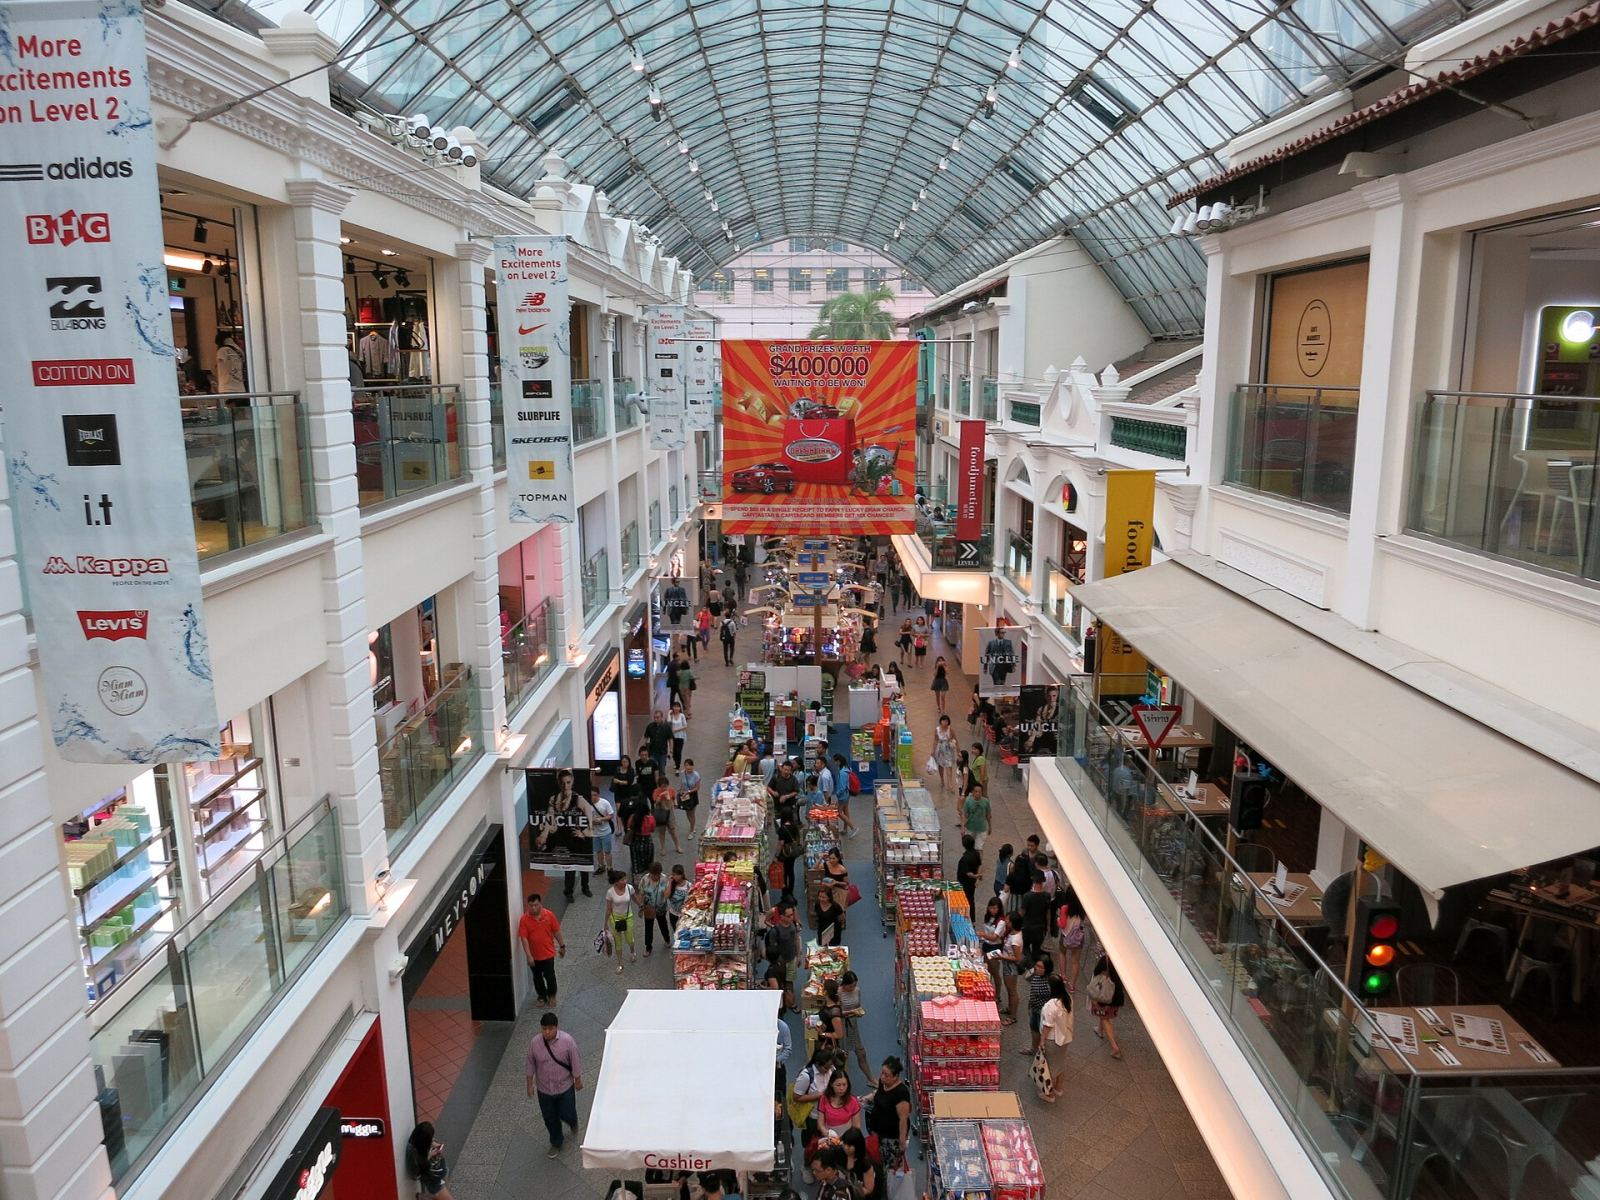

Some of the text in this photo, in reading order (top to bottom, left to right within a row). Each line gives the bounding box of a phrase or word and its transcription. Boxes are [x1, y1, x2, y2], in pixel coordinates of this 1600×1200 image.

[18, 35, 82, 58] More
[0, 66, 132, 91] xcitements
[30, 98, 98, 122] Level
[105, 97, 120, 119] 2
[47, 157, 133, 180] adidas
[28, 212, 110, 243] BHG
[518, 248, 543, 256] More
[502, 260, 561, 269] Excitements
[522, 271, 548, 280] Level
[551, 271, 556, 279] 2
[769, 344, 872, 353] GRAND PRIZES WORTH
[38, 364, 130, 381] COTTON ON
[517, 411, 560, 422] SLURPLIFE
[511, 436, 569, 445] SKECHERS
[967, 446, 981, 519] foodjunction
[519, 494, 567, 502] TOPMAN
[84, 494, 114, 526] i.t
[76, 556, 169, 577] Kappa
[101, 679, 133, 693] Miam
[110, 689, 144, 702] Miam
[434, 863, 485, 952] MEYSON
[644, 1153, 712, 1170] Cashier
